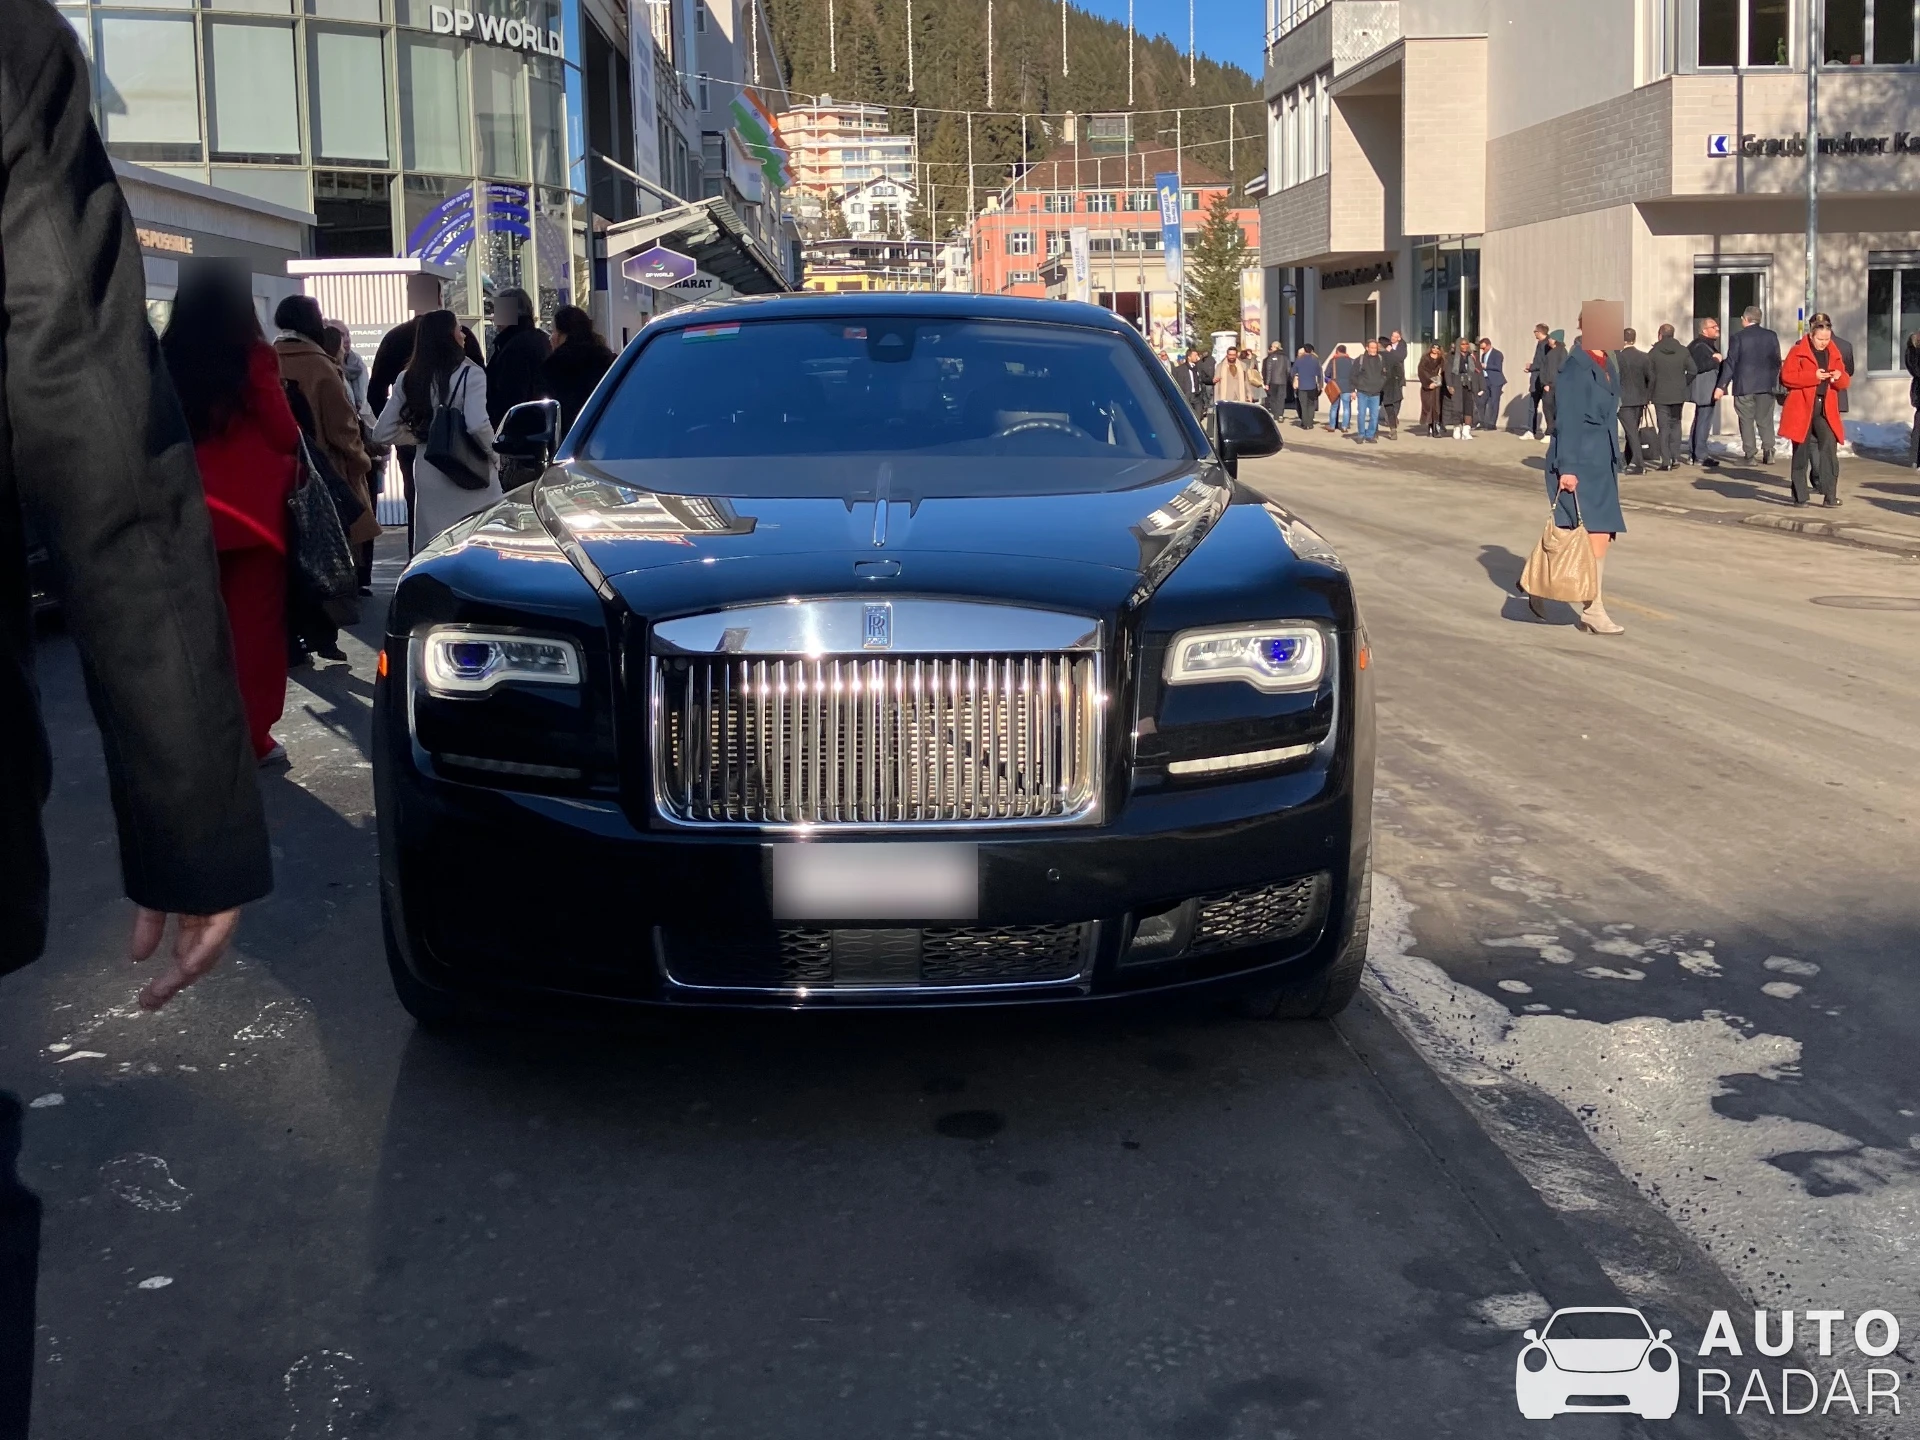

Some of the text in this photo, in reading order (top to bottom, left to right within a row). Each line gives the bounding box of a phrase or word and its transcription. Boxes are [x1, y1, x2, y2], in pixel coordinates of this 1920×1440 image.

[430, 4, 562, 58] DP WORLD
[1741, 131, 1889, 156] Graubndner
[442, 192, 471, 212] STEP INTO
[668, 279, 713, 289] HARAT
